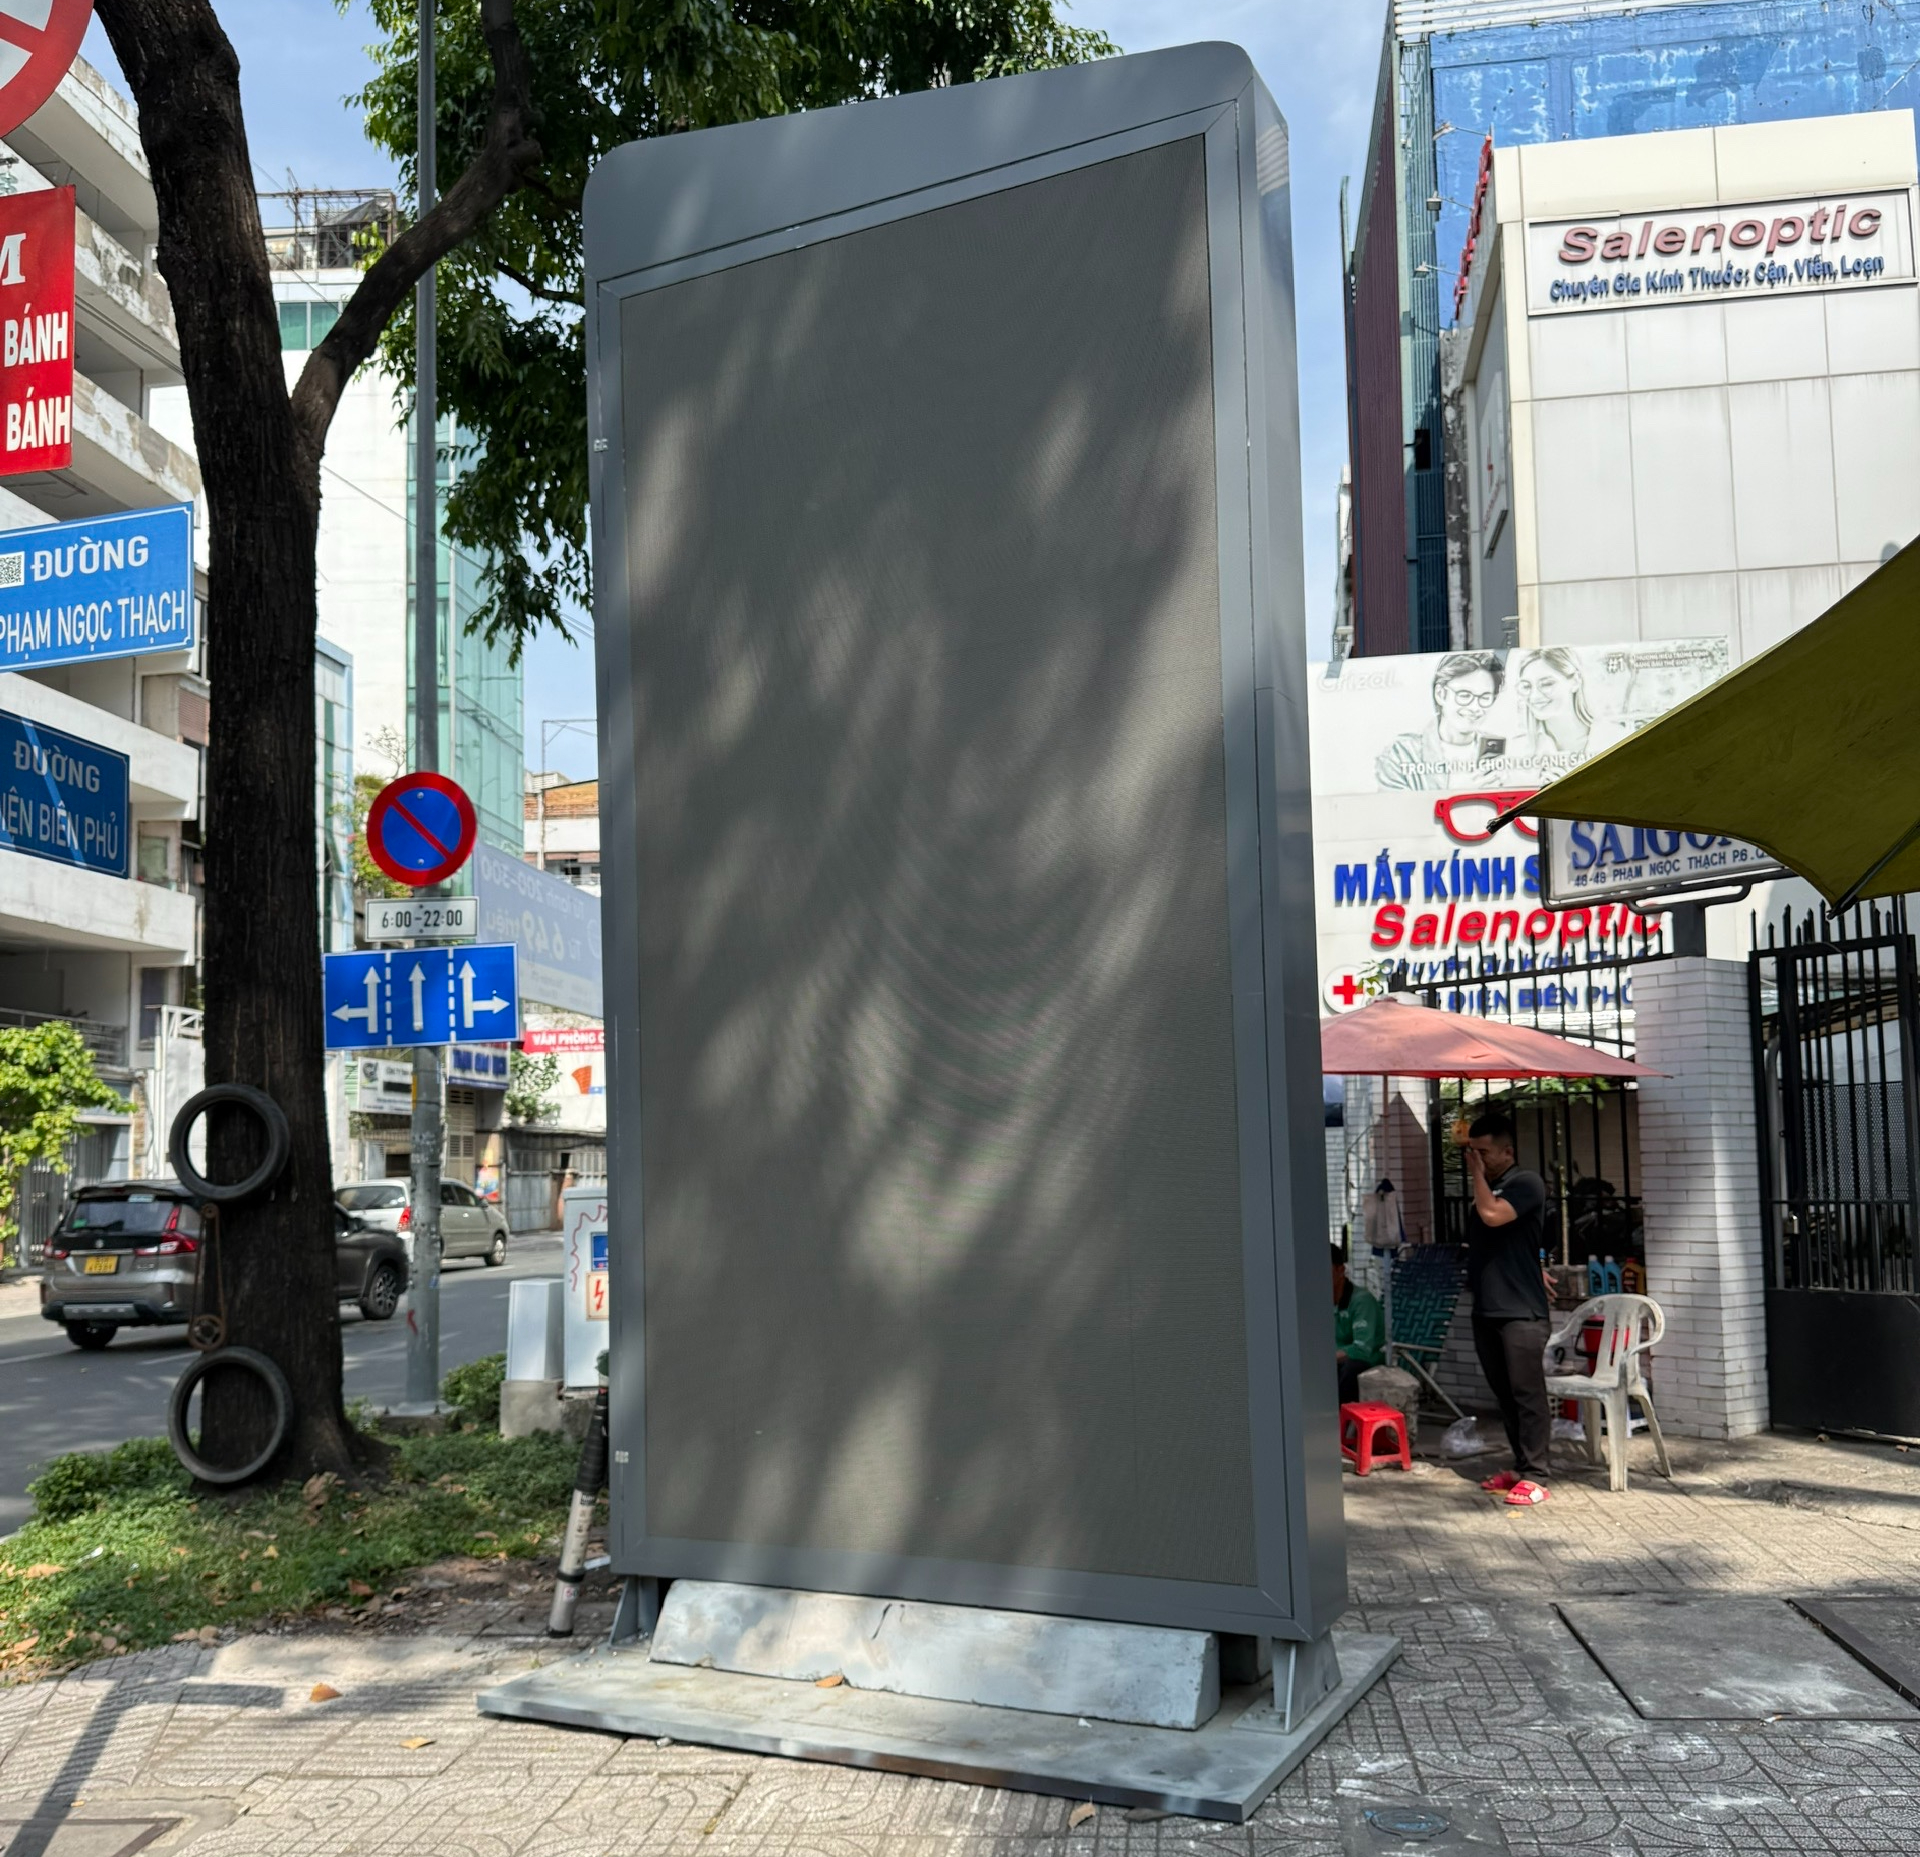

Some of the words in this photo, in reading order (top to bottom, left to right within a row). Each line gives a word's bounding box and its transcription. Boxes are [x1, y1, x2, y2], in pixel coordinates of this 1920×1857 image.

[1558, 204, 1882, 262] Salenoptic
[1550, 274, 1609, 302] Chuyên
[1614, 272, 1641, 293] Gia
[1646, 267, 1684, 292] Kính
[1841, 255, 1885, 281] Loạn
[4, 303, 69, 367] BÁNH
[6, 386, 71, 452] BÁNH
[30, 535, 149, 582] ĐƯỜNG
[58, 600, 112, 651] NGỌC
[117, 589, 185, 644] THẠCH
[13, 739, 100, 793] ĐƯỜNG
[39, 800, 79, 850] BIÊN
[84, 811, 118, 860] PHỦ
[1571, 821, 1733, 870] SAIG
[1334, 848, 1416, 901] MẮT
[1423, 849, 1515, 900] KÍNH
[1613, 866, 1643, 882] PHẠM
[1650, 859, 1680, 877] NGỌC
[1688, 851, 1726, 869] THẠCH
